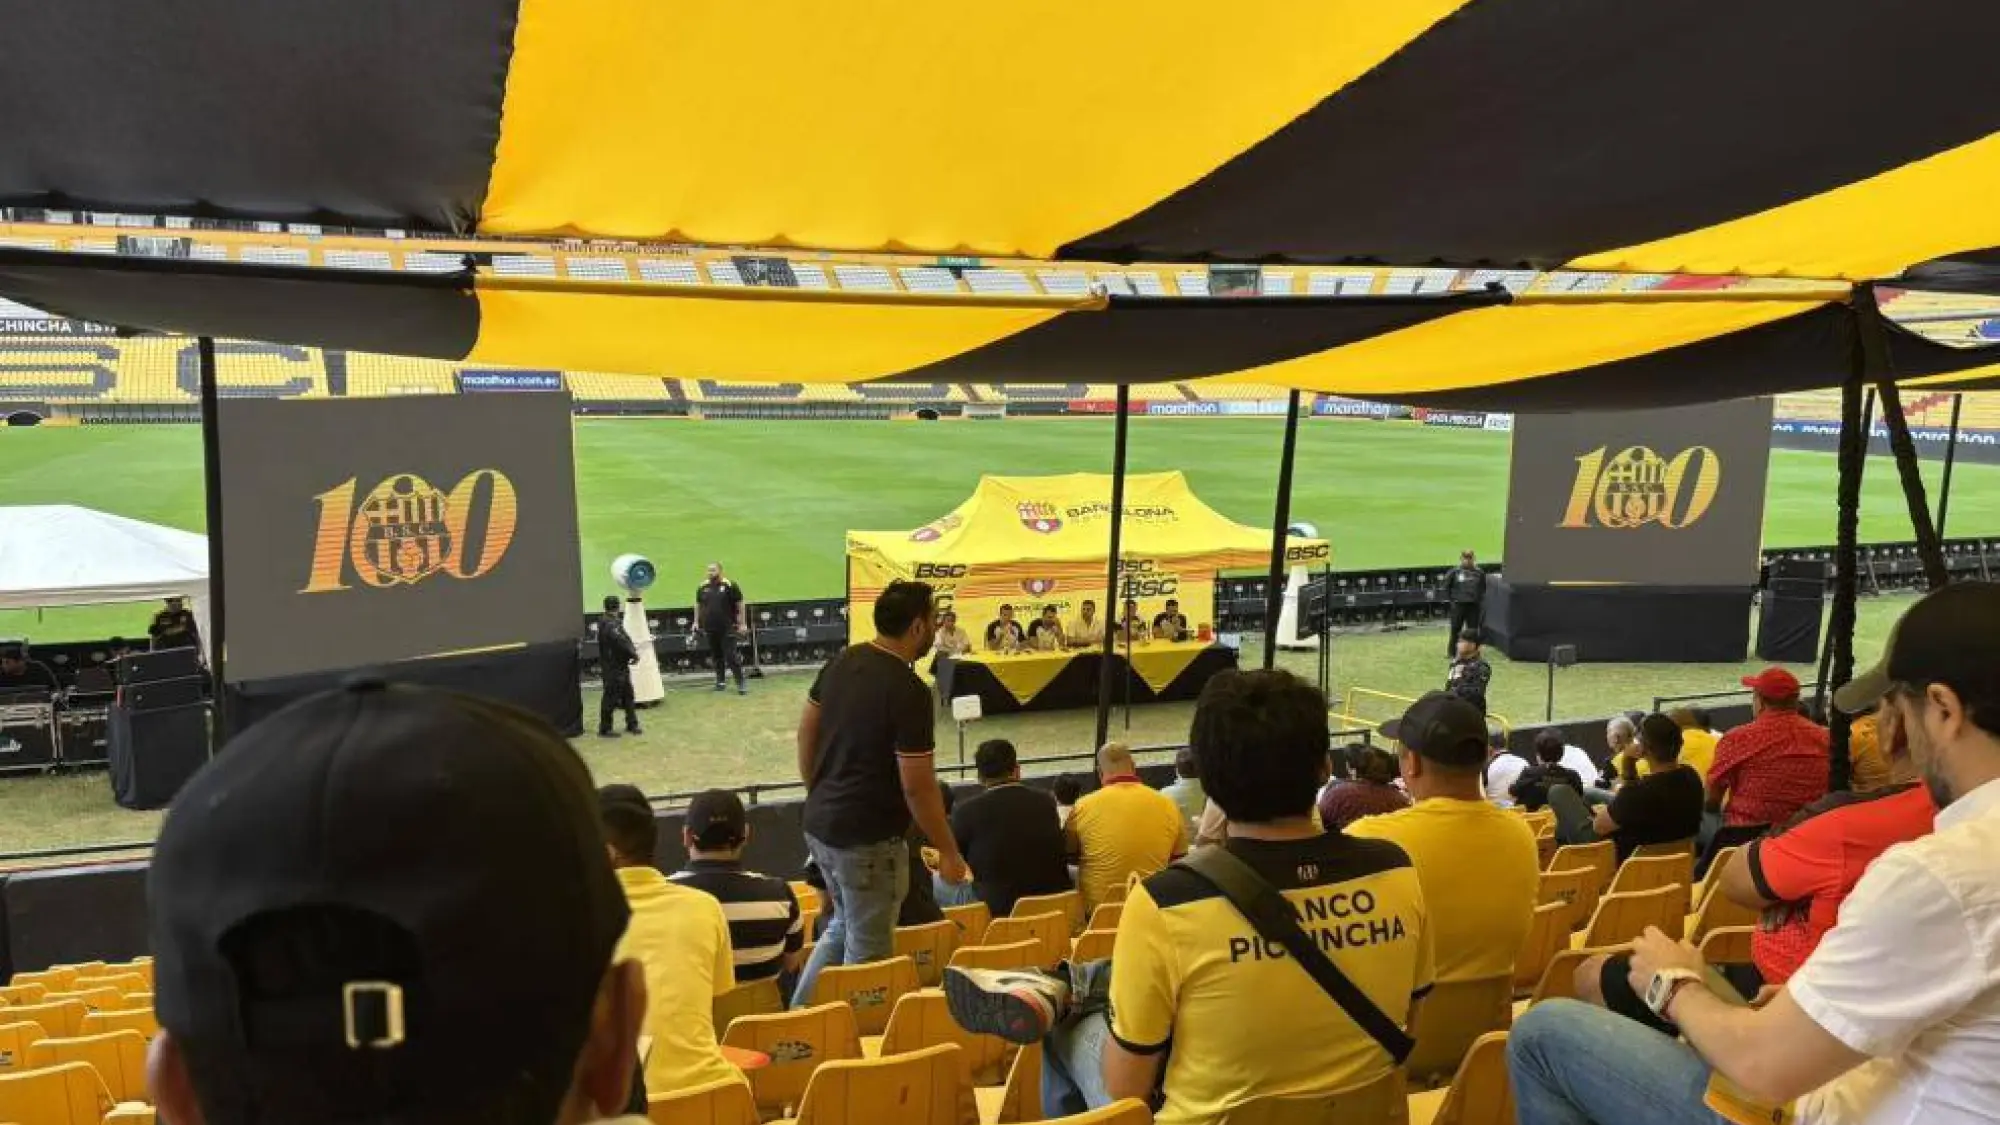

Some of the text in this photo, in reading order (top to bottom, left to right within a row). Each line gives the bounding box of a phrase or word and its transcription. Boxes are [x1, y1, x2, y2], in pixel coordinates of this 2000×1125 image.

[1152, 400, 1217, 414] marathon
[1324, 401, 1390, 414] marathon
[1556, 445, 1720, 528] 100
[297, 468, 518, 594] 100
[1287, 543, 1330, 560] BSC
[914, 563, 967, 579] BSC
[1118, 578, 1179, 599] BSC
[1296, 888, 1376, 924] NCO
[1228, 914, 1407, 964] PICINCHA
